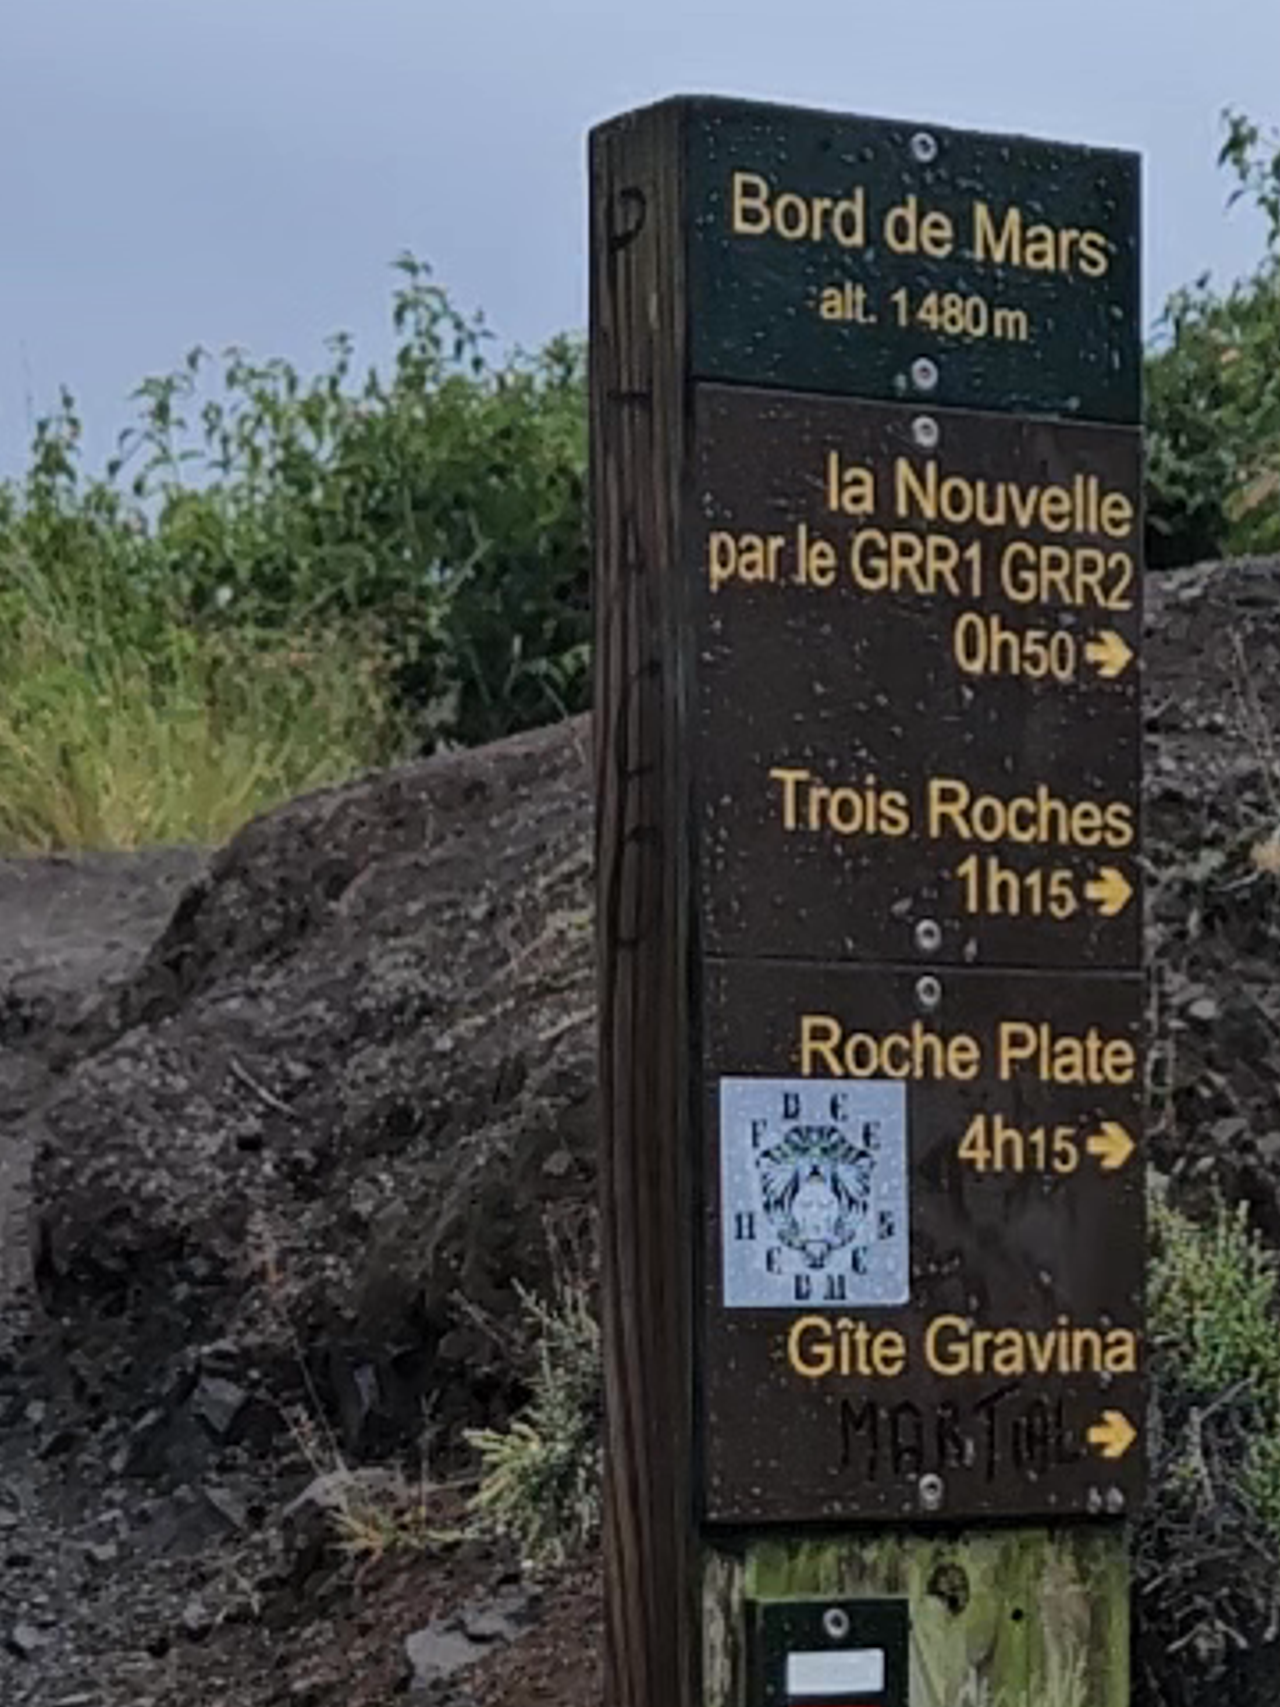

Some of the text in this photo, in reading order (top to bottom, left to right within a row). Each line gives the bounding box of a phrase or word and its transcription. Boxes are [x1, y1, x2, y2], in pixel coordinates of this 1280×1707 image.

[731, 172, 1109, 276] Bord de Mars
[819, 279, 877, 324] alt.
[827, 451, 1132, 539] la Nouvelle
[708, 524, 1132, 611] par le GRR1 GRR2
[952, 611, 1077, 678] 0h50
[770, 767, 1135, 848] Trois Roches
[956, 853, 1079, 921] 1h15
[799, 1014, 1137, 1085] Roche Plate
[956, 1113, 1081, 1174] 4h15
[787, 1313, 1137, 1379] Gîte Gravina
